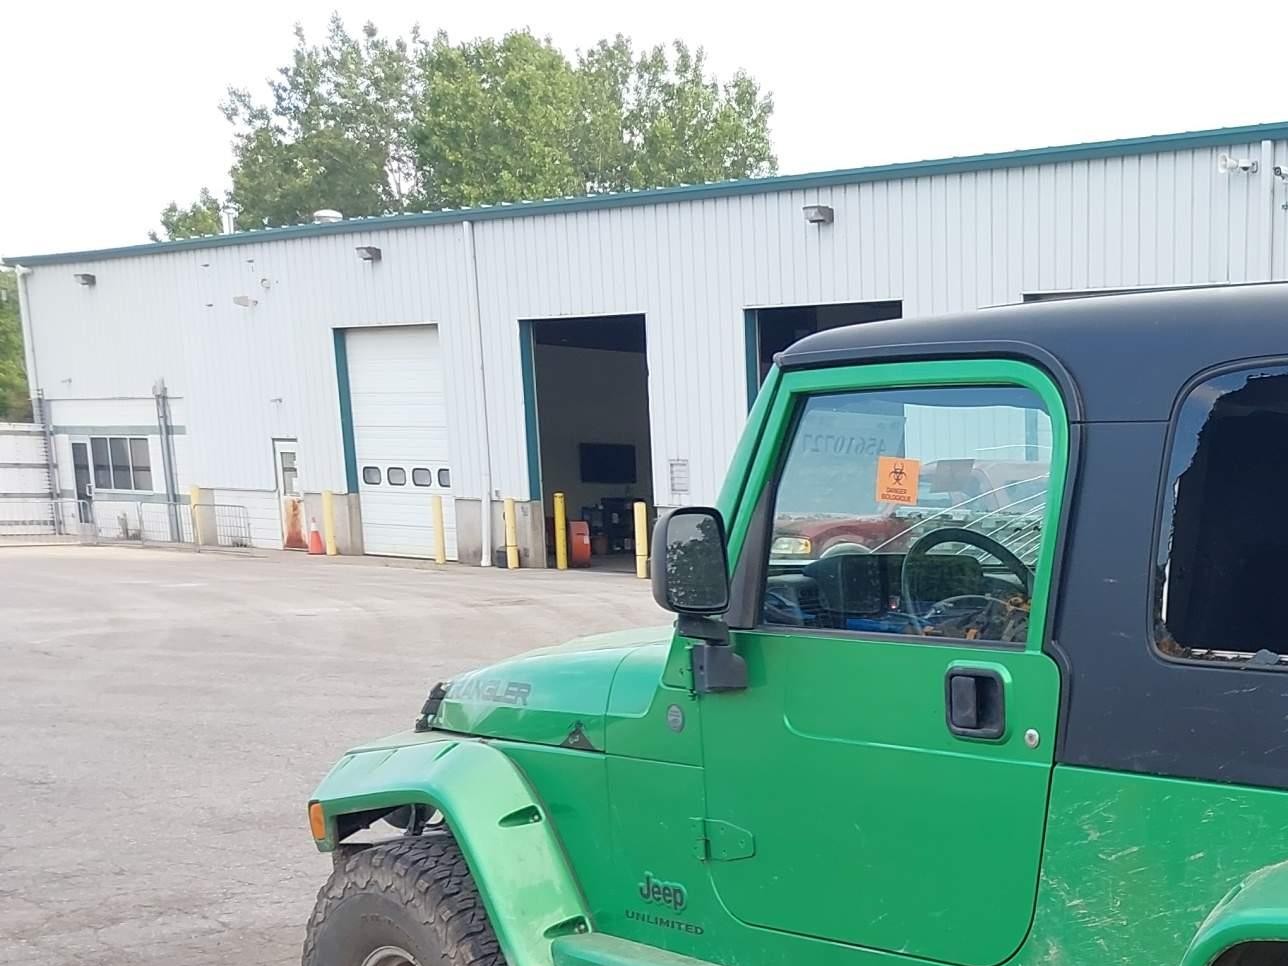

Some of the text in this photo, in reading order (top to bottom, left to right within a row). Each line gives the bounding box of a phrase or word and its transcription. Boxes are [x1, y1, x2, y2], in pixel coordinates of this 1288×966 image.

[446, 680, 532, 706] RANGLER
[639, 874, 686, 912] Jeep
[625, 909, 704, 935] UNLIMITED
